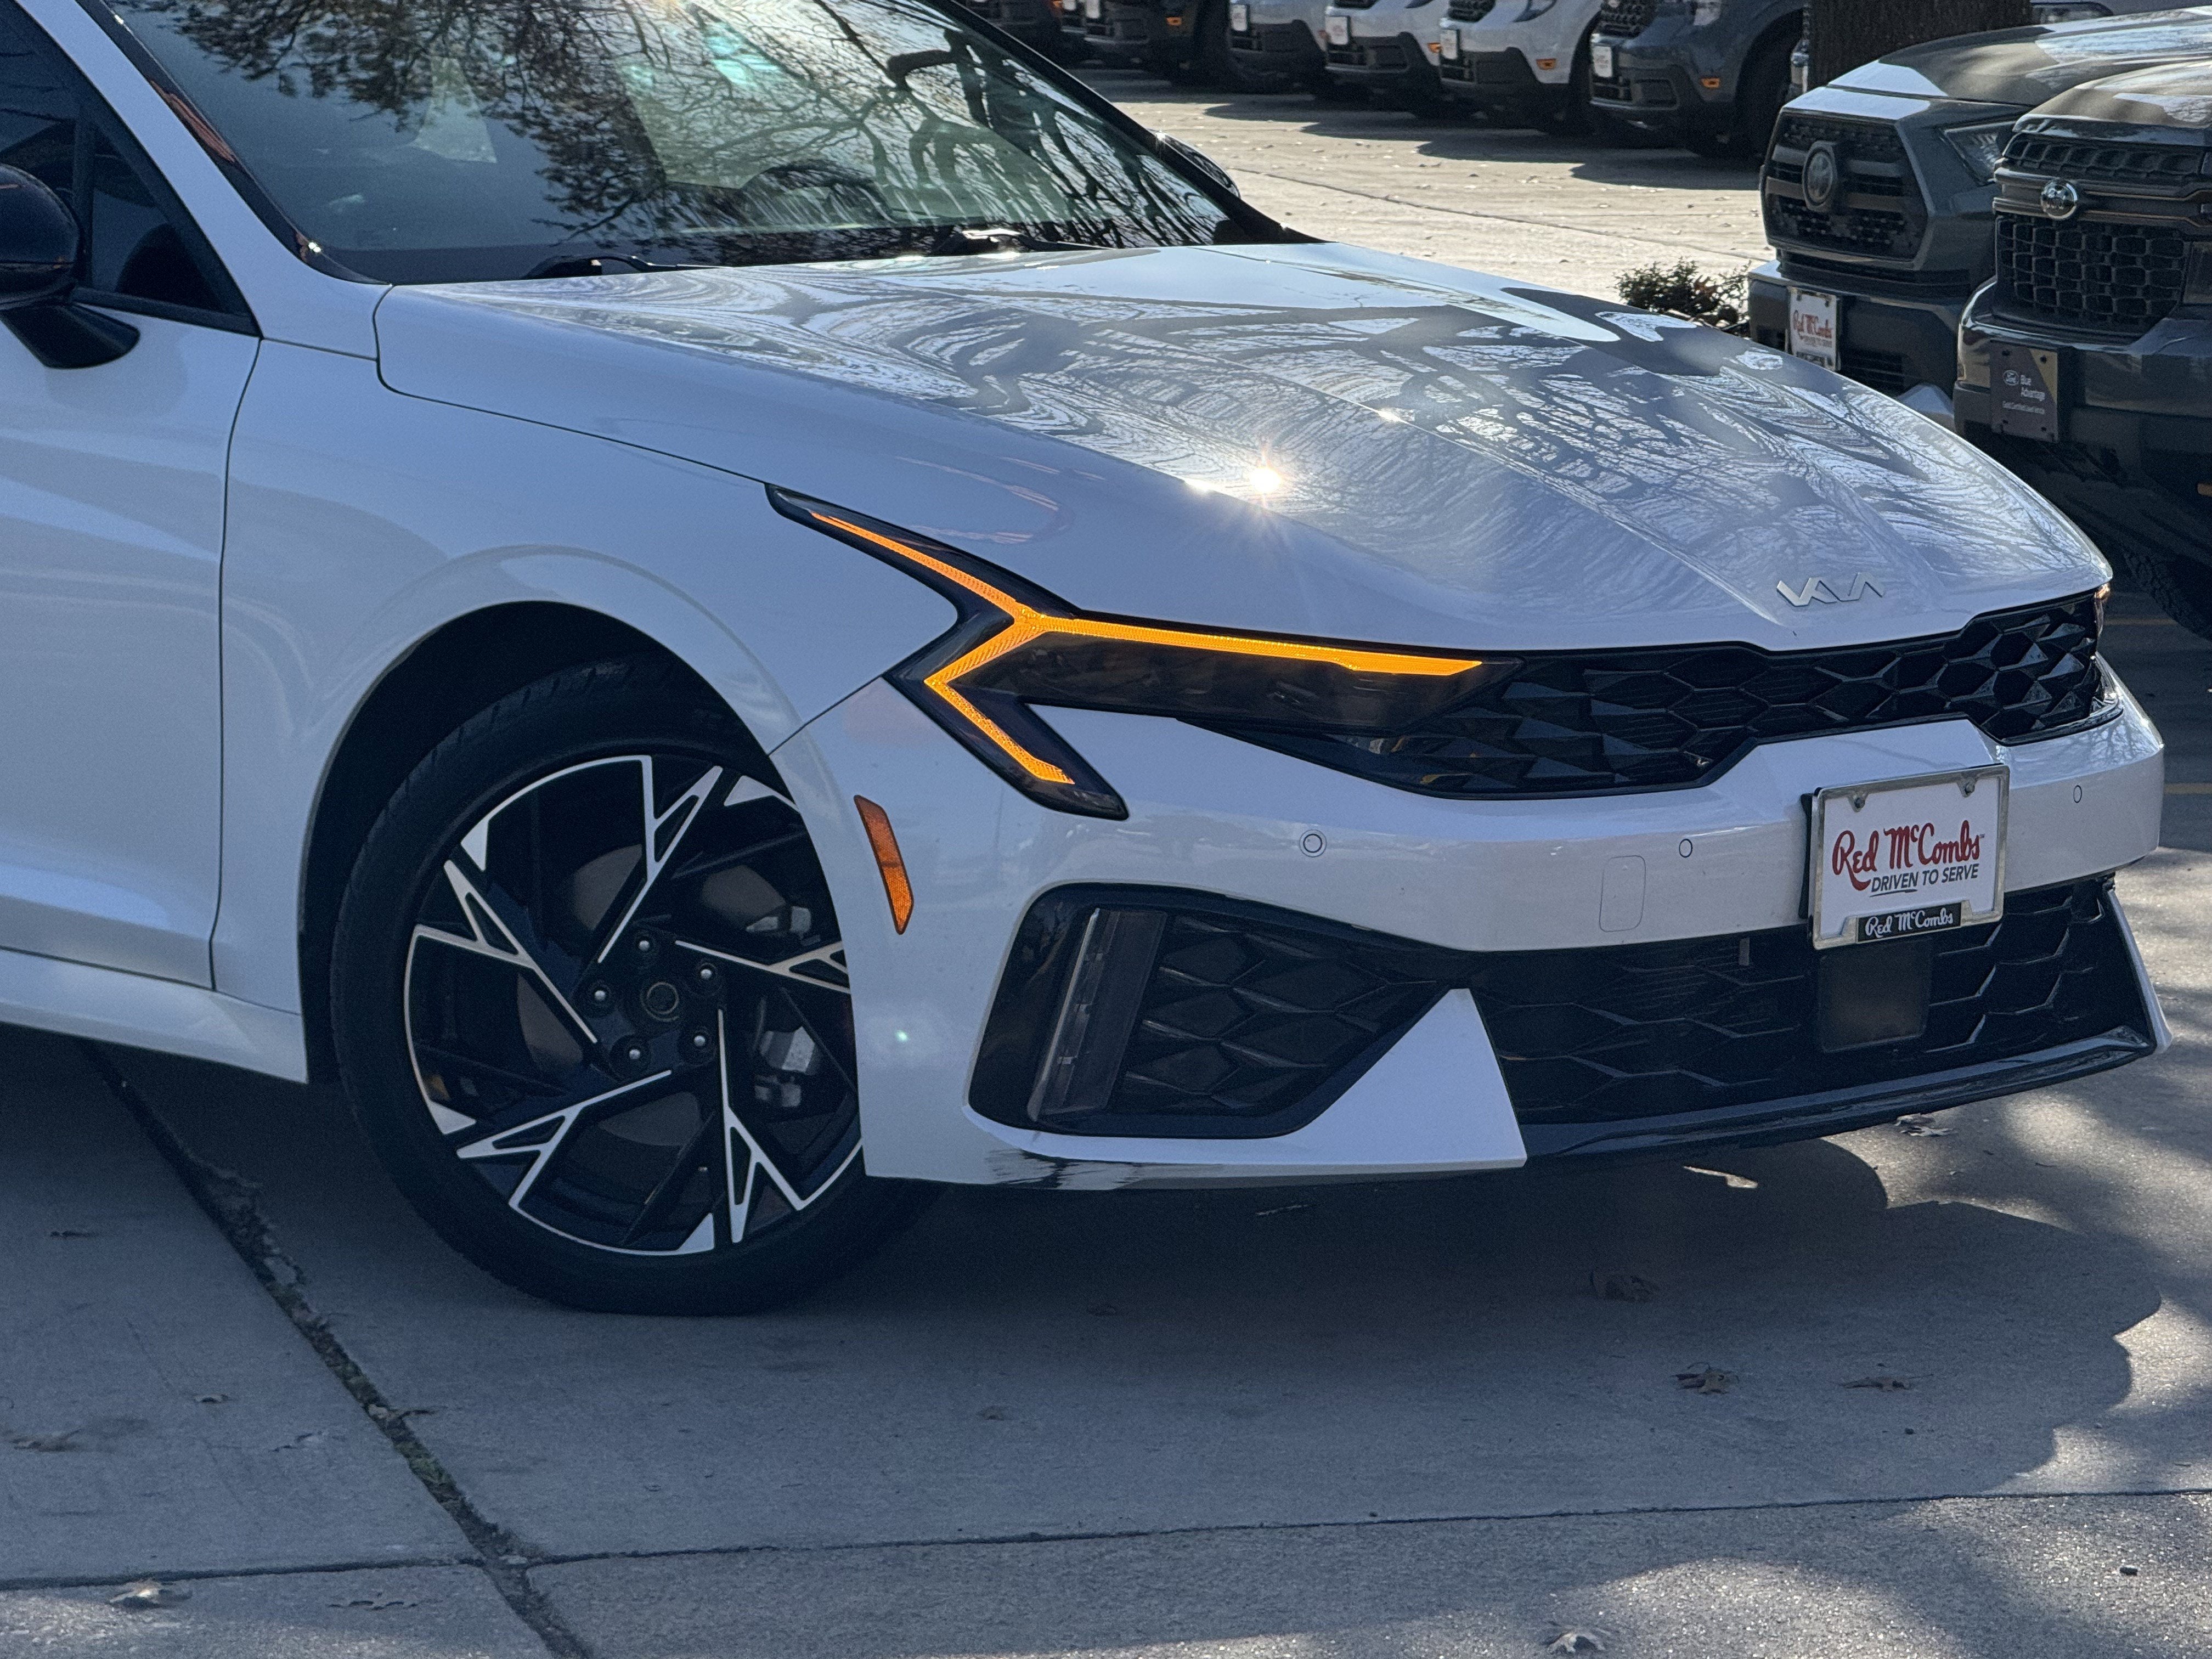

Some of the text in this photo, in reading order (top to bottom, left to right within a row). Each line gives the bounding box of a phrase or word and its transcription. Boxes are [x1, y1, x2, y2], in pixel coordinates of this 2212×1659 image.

[1832, 820, 1980, 891] Red McCombs
[1871, 864, 1979, 892] DRIVEN TO SERVE
[1865, 907, 1953, 938] Red McCombs
